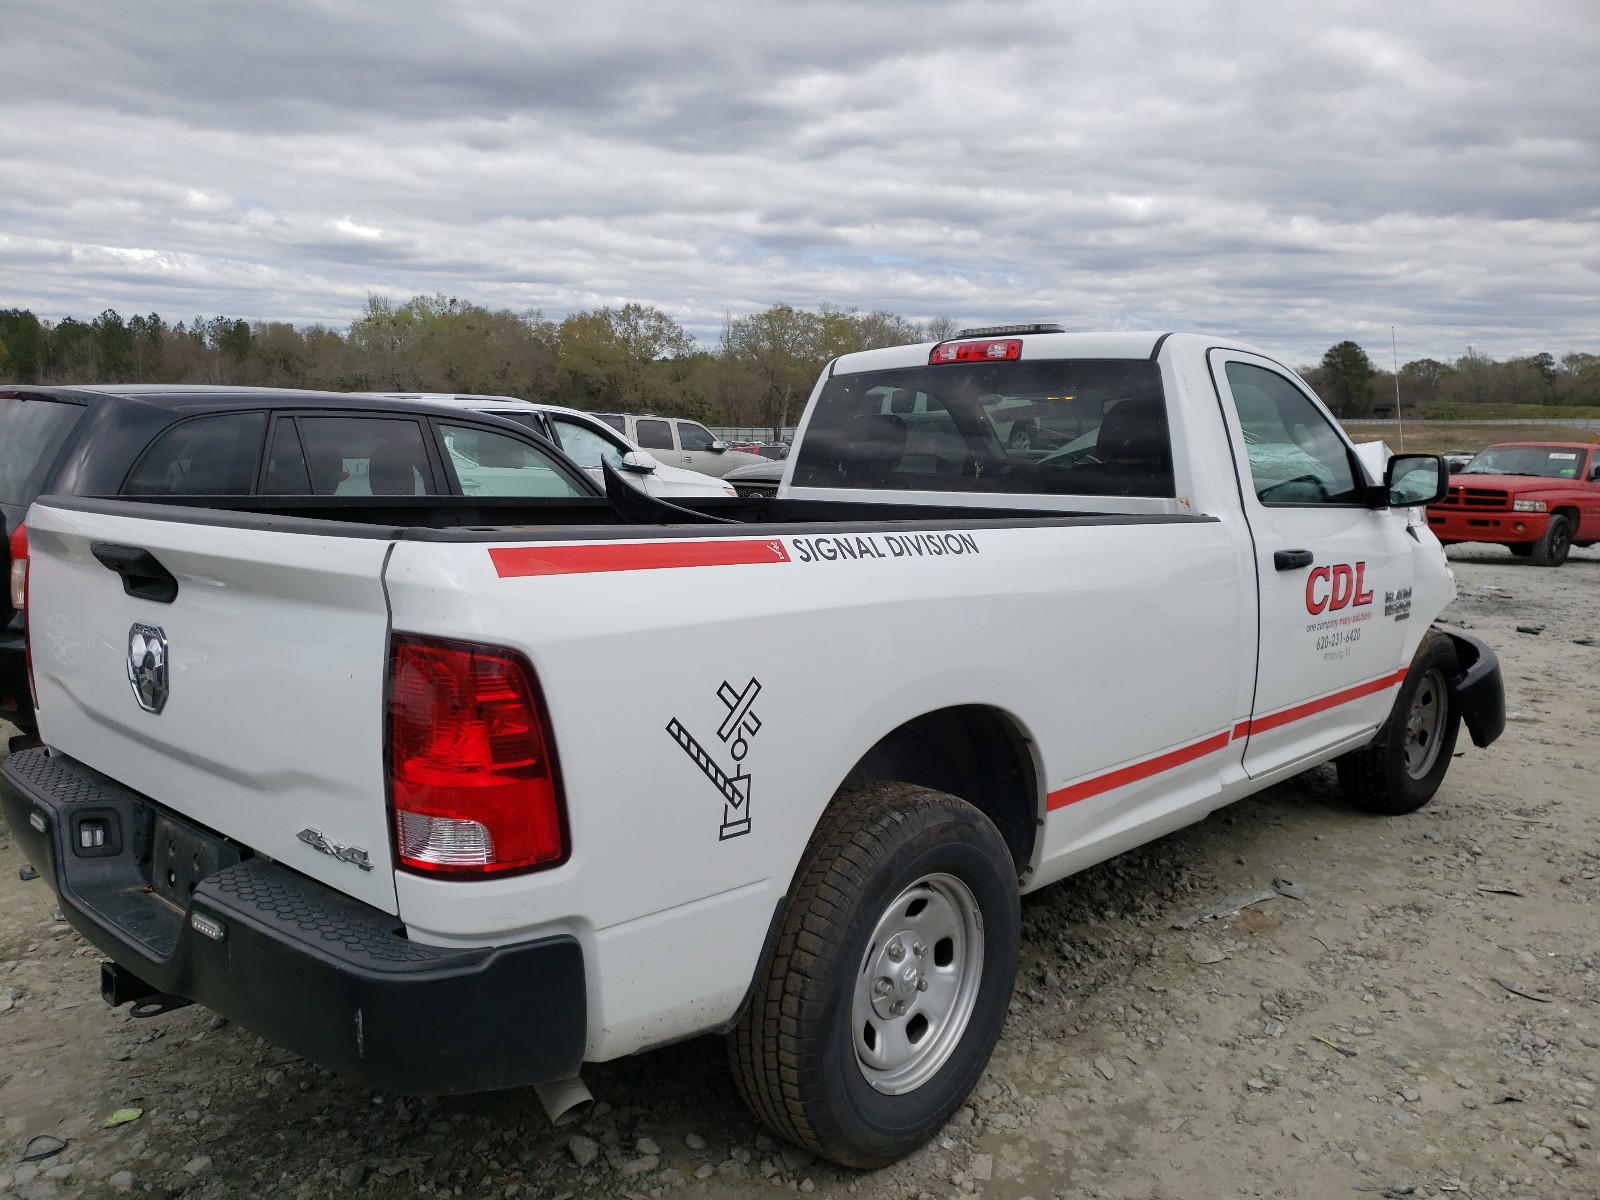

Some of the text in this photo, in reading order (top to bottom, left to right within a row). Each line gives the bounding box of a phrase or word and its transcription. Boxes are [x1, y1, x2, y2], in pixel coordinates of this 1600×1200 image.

[792, 533, 980, 562] SIGNAL DIVISION
[1305, 560, 1374, 615] CDL
[1316, 627, 1361, 650] 620-231-6420
